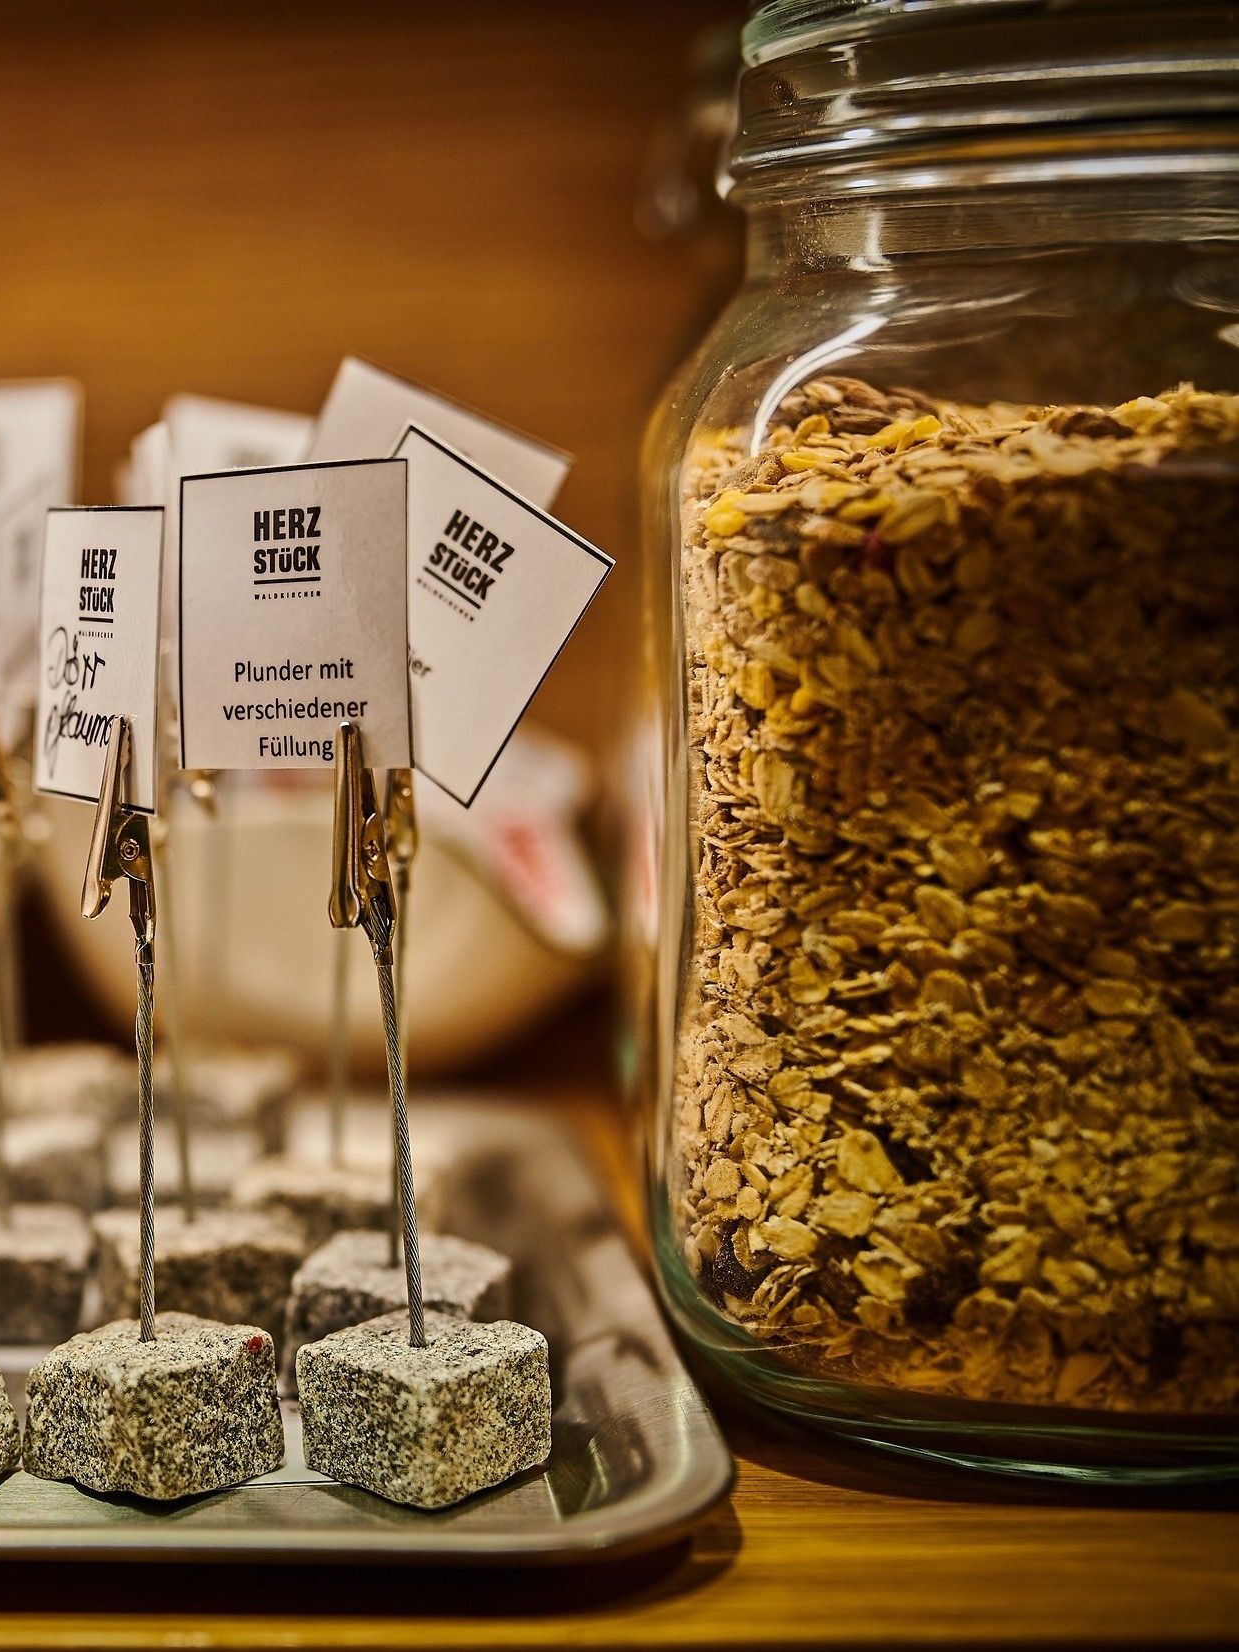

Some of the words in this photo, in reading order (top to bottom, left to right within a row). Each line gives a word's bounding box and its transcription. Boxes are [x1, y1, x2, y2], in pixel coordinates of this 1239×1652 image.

[254, 506, 321, 541] HERZ
[444, 509, 515, 574] HERZ
[81, 549, 117, 580] HERZ
[254, 590, 321, 600] WALDKIRCHEN
[235, 659, 313, 682] Plunder
[320, 657, 354, 679] mit
[223, 697, 368, 720] verschiedener
[259, 735, 334, 761] Füllung
